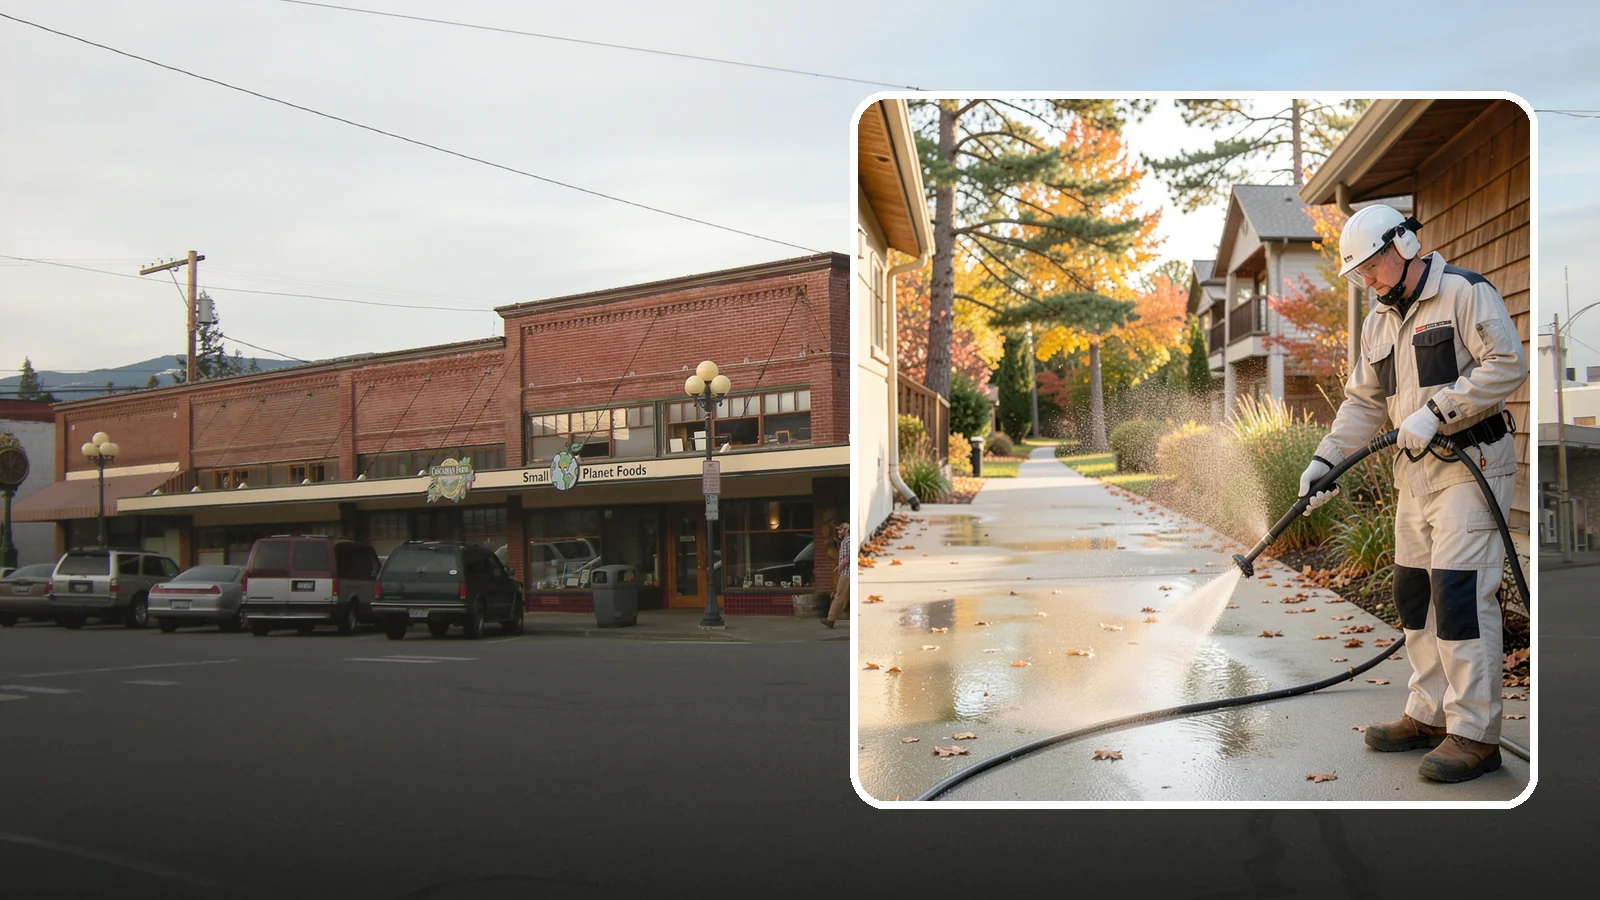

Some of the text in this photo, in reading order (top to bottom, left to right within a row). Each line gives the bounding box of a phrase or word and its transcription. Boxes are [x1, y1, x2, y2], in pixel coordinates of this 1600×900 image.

[431, 466, 469, 476] CASCADIAN FARM
[523, 464, 647, 483] Small Planet Foods
